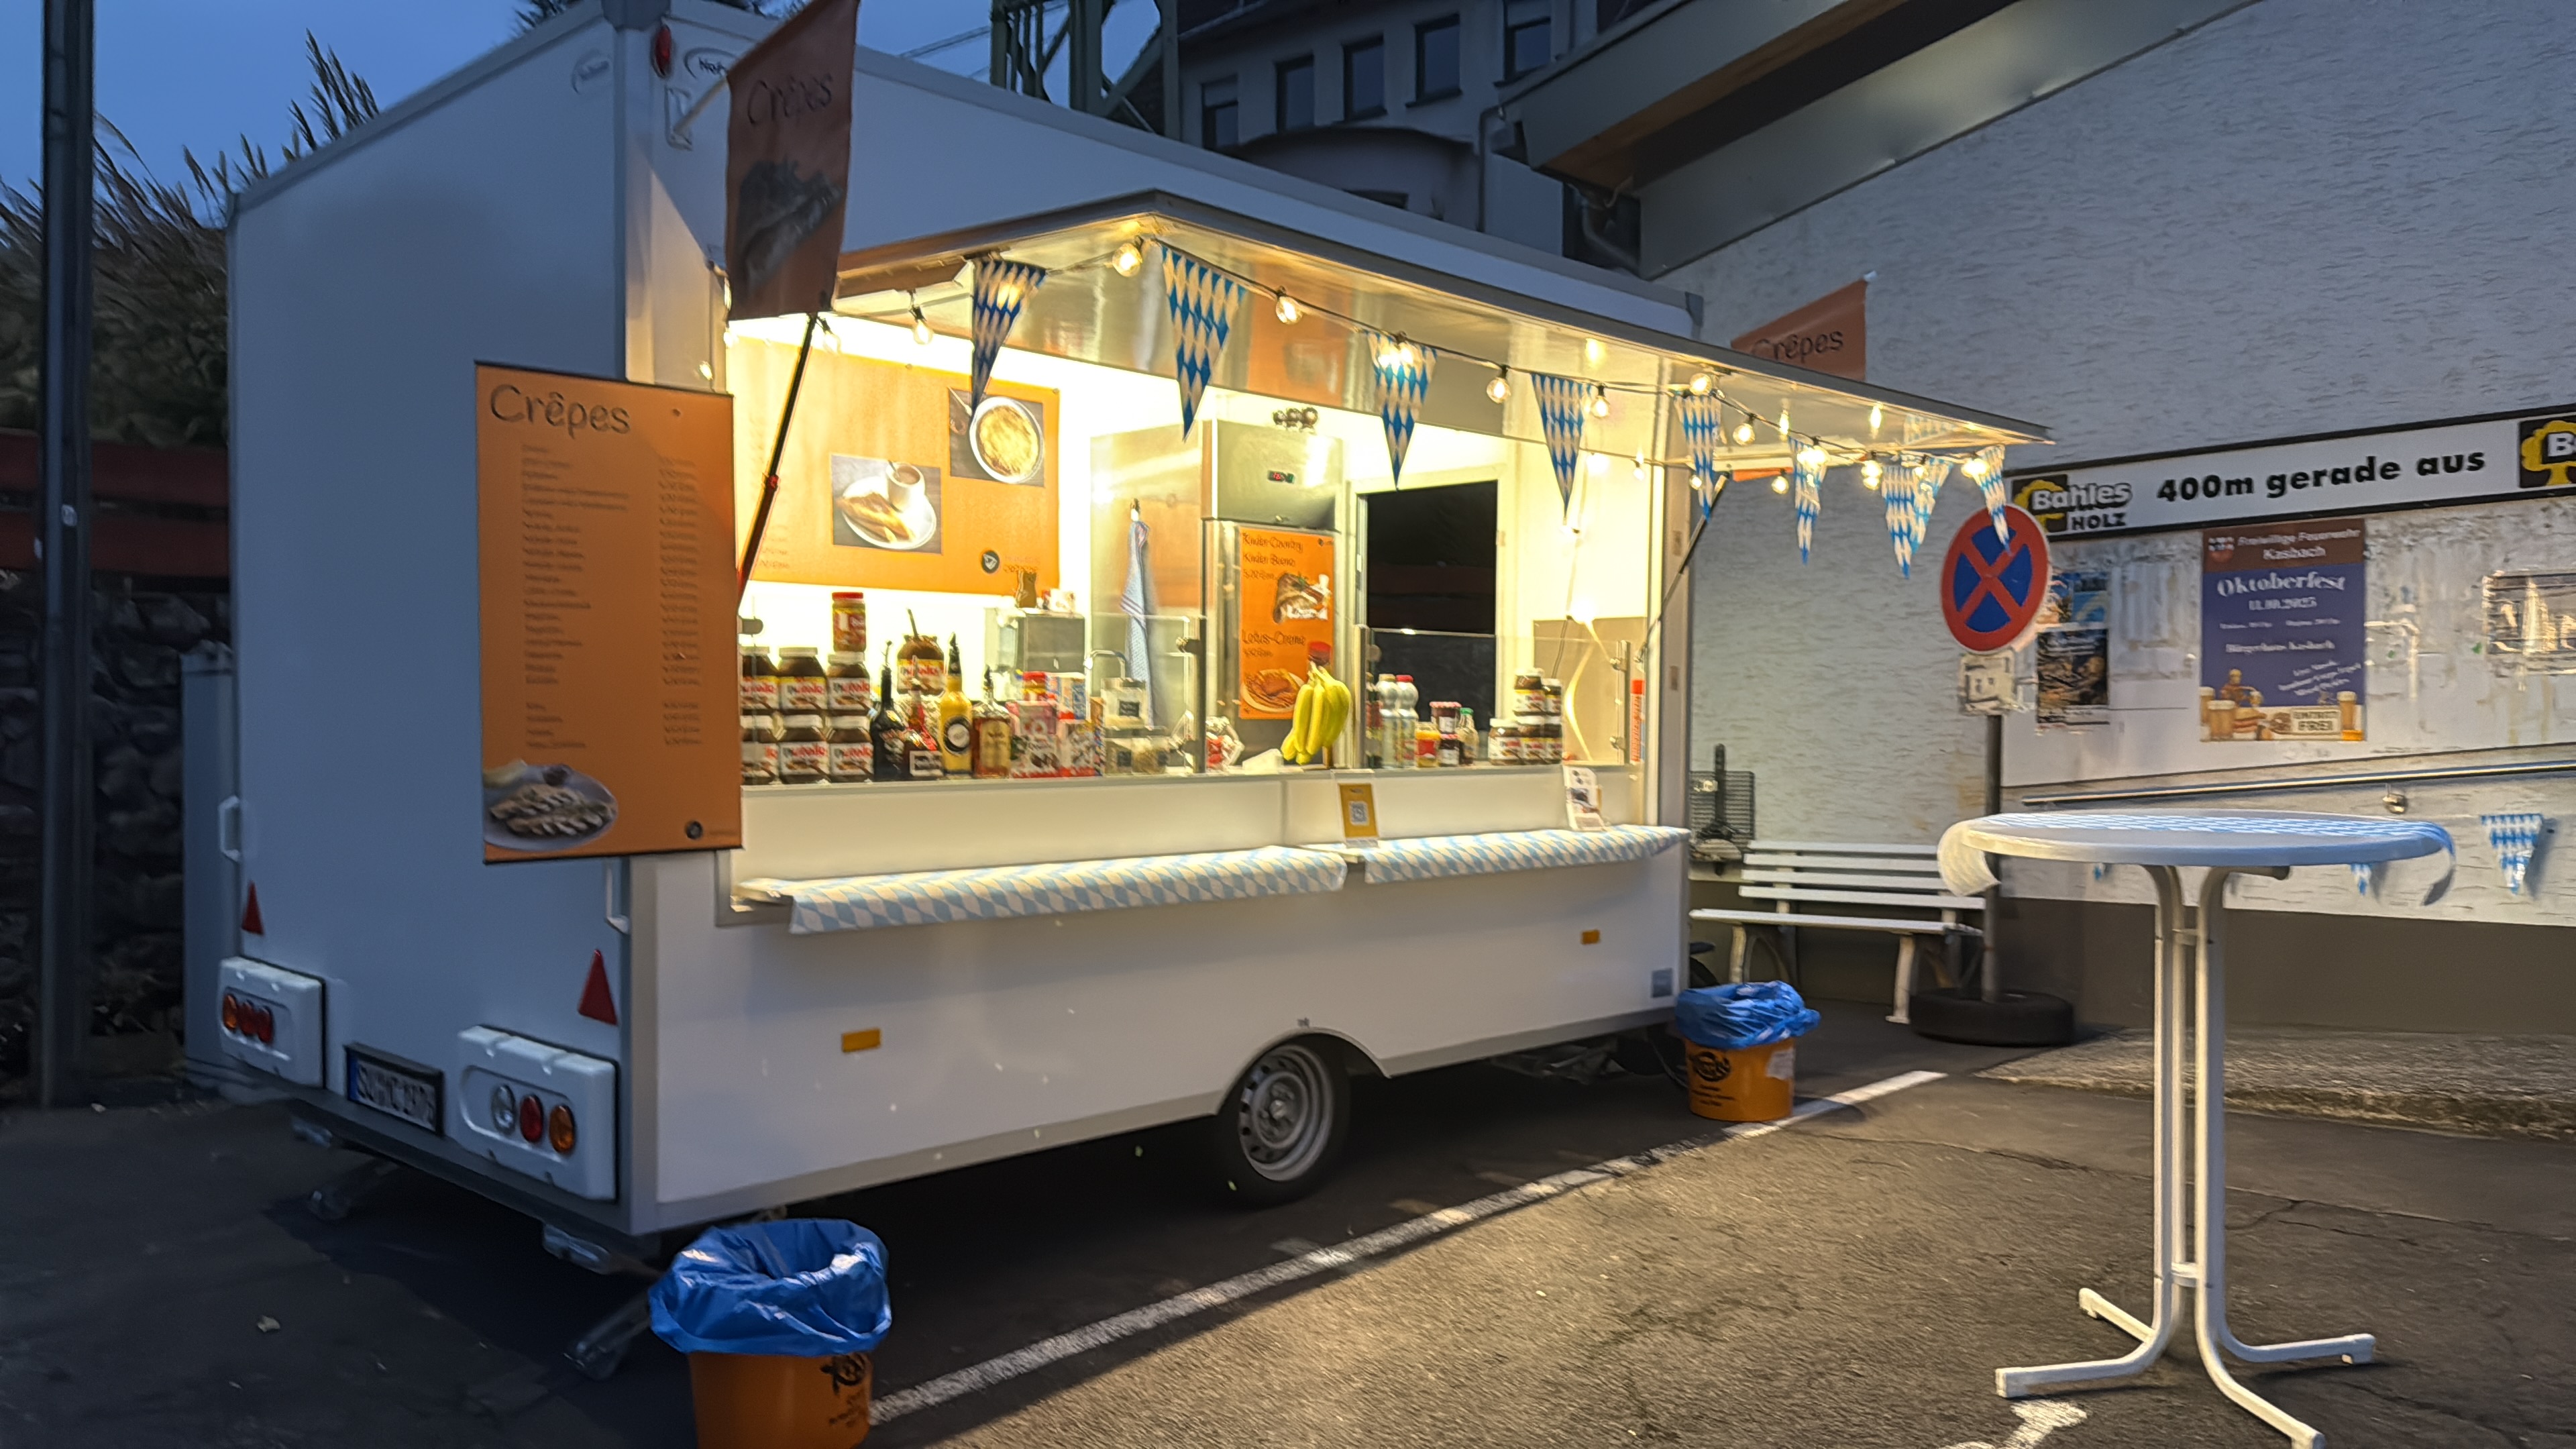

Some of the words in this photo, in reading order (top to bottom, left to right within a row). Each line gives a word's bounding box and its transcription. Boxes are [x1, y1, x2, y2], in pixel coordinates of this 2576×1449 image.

[490, 384, 631, 440] Crêpes
[2157, 474, 2255, 502] 400m
[2266, 455, 2401, 498] gerade
[2416, 451, 2485, 476] aus
[2031, 482, 2132, 511] Bahles
[2071, 512, 2127, 531] HOLZ
[2216, 572, 2347, 597] Oktoberfest
